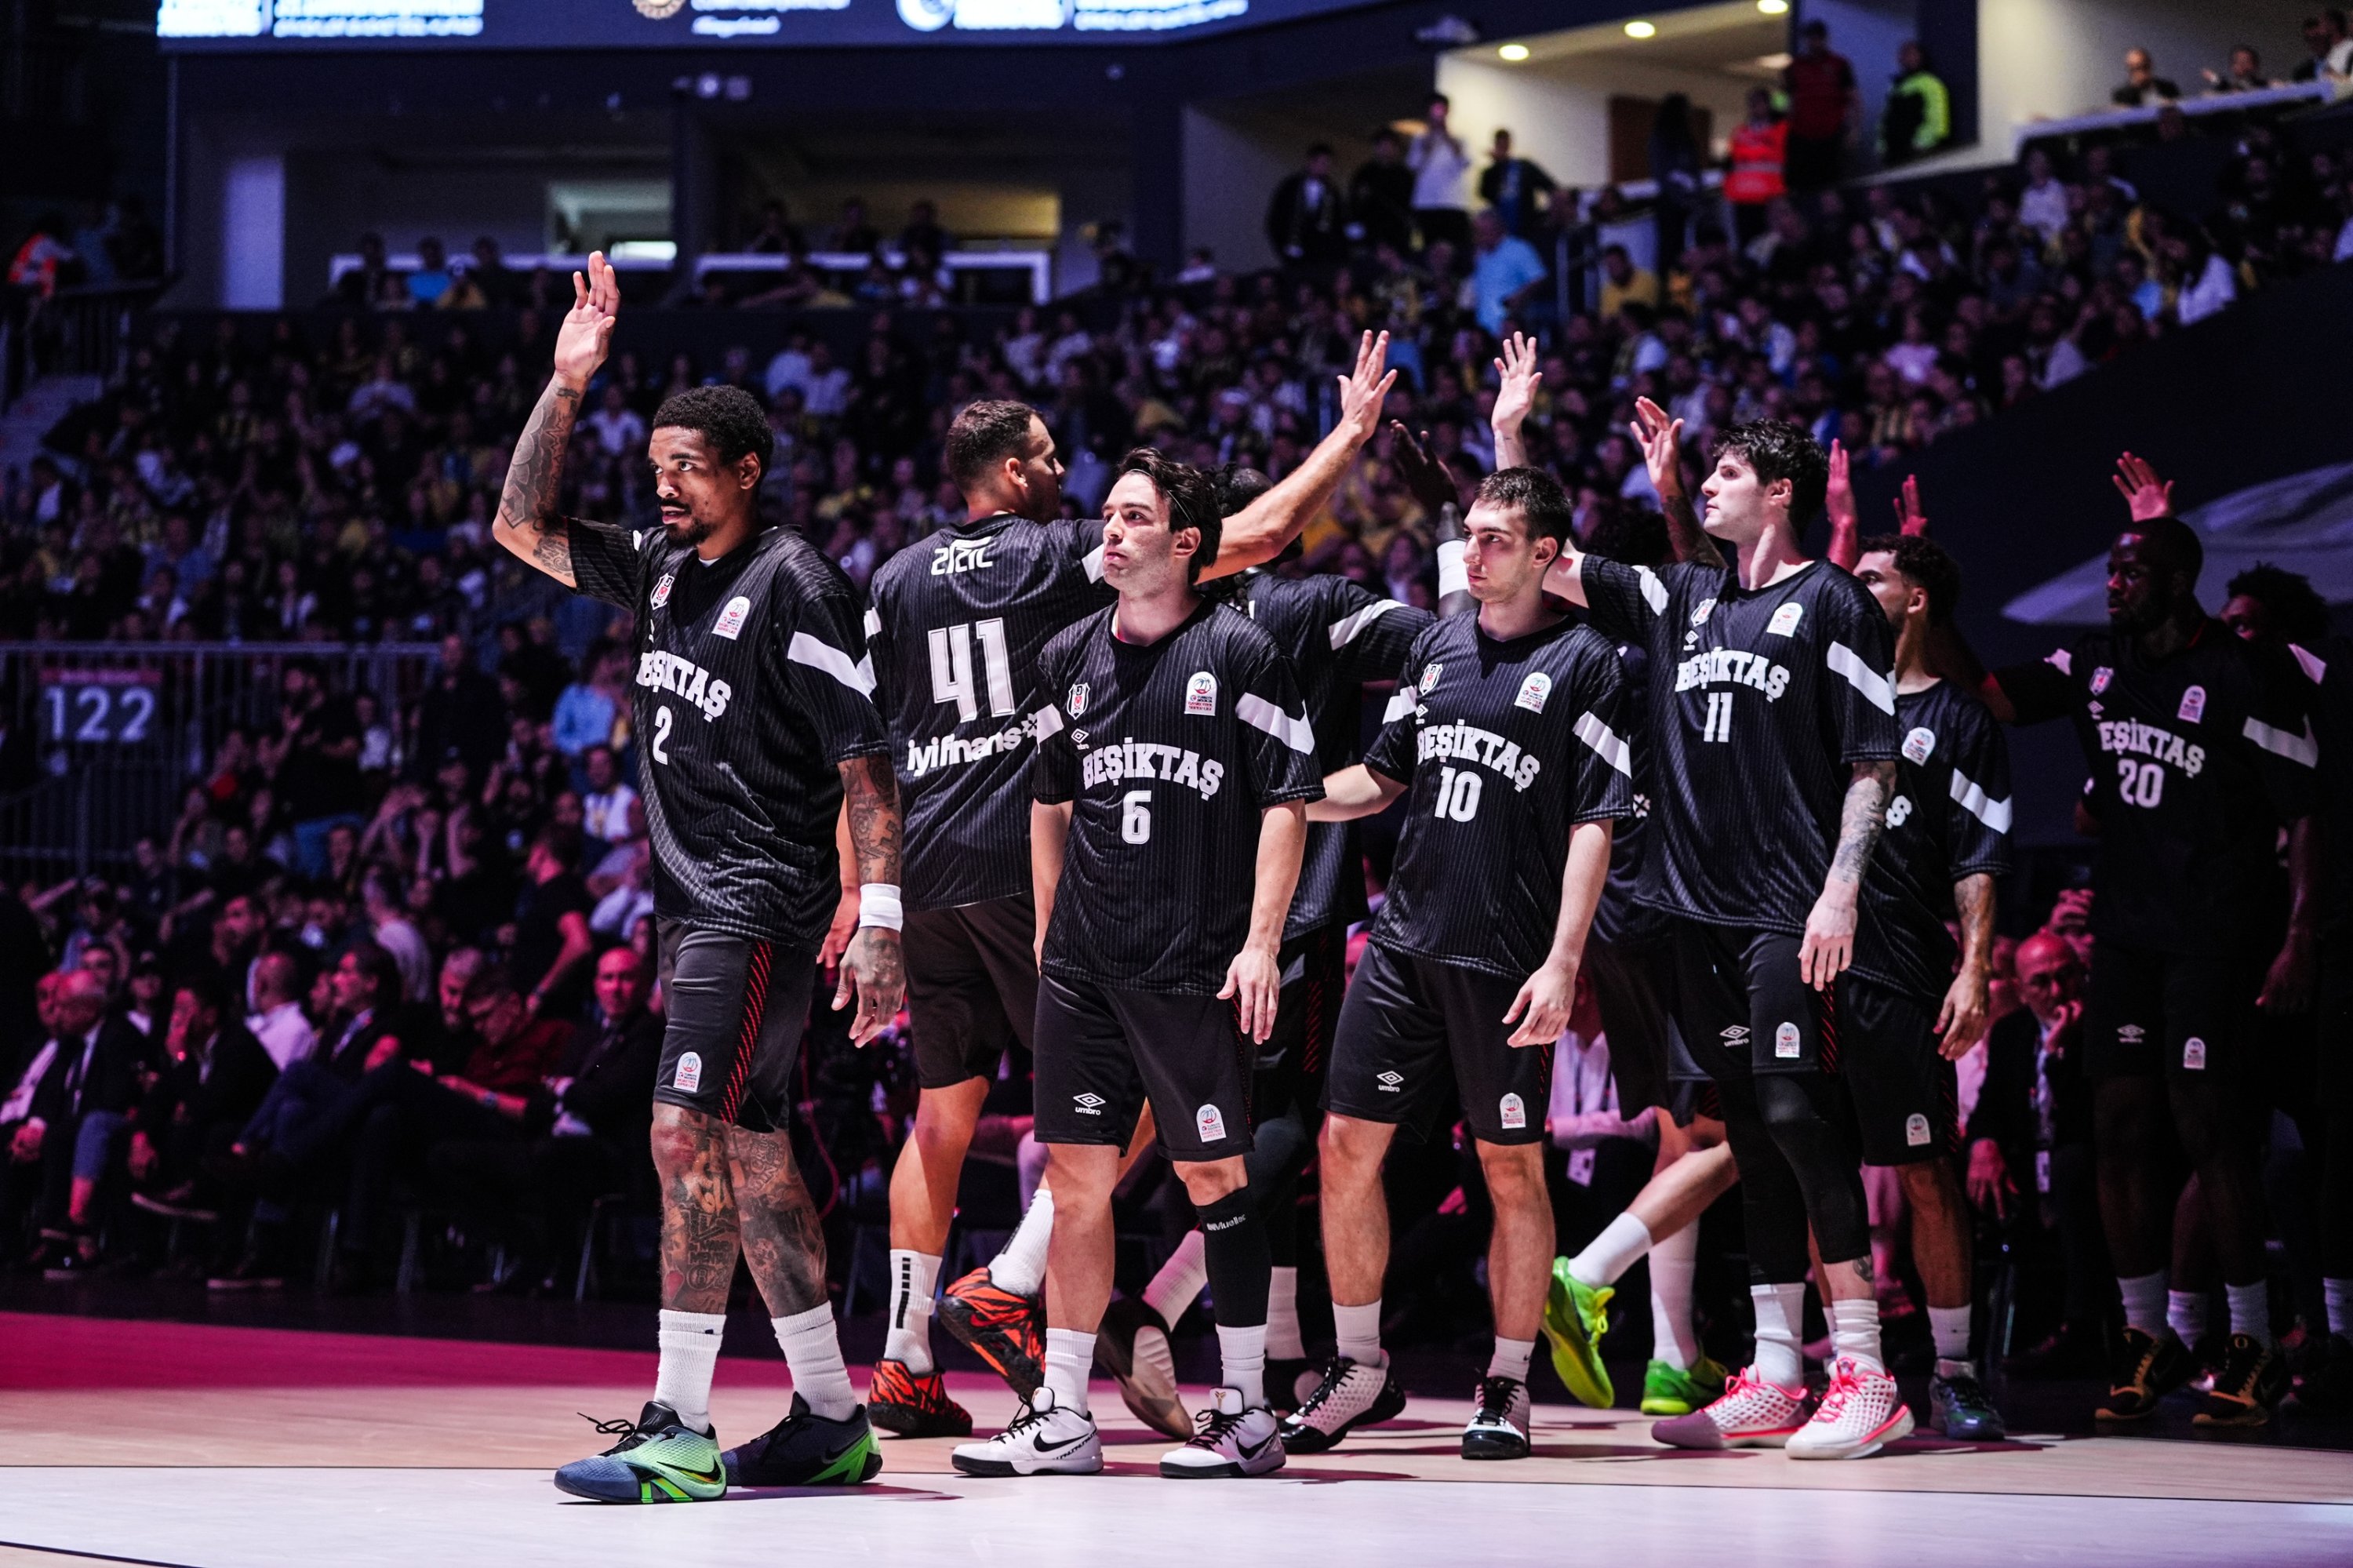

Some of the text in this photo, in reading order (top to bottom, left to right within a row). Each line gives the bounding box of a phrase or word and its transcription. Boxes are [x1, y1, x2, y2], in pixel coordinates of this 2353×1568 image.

[636, 649, 732, 722] BŞKTAŞ
[928, 617, 1016, 723] 41
[1675, 646, 1791, 703] BEŞİKTAŞ
[45, 686, 155, 740] 122
[653, 705, 672, 766] 2
[1704, 692, 1733, 743] 11
[1082, 737, 1224, 801] BEŞİKTAŞ
[1417, 719, 1540, 792] BEŞİKTAŞ
[2097, 717, 2206, 778] EŞİKTAŞ
[1435, 766, 1482, 822] 10
[2118, 758, 2165, 809] 20
[1122, 790, 1152, 845] 6
[1075, 1106, 1101, 1115] umbro
[1378, 1084, 1400, 1093] umbro
